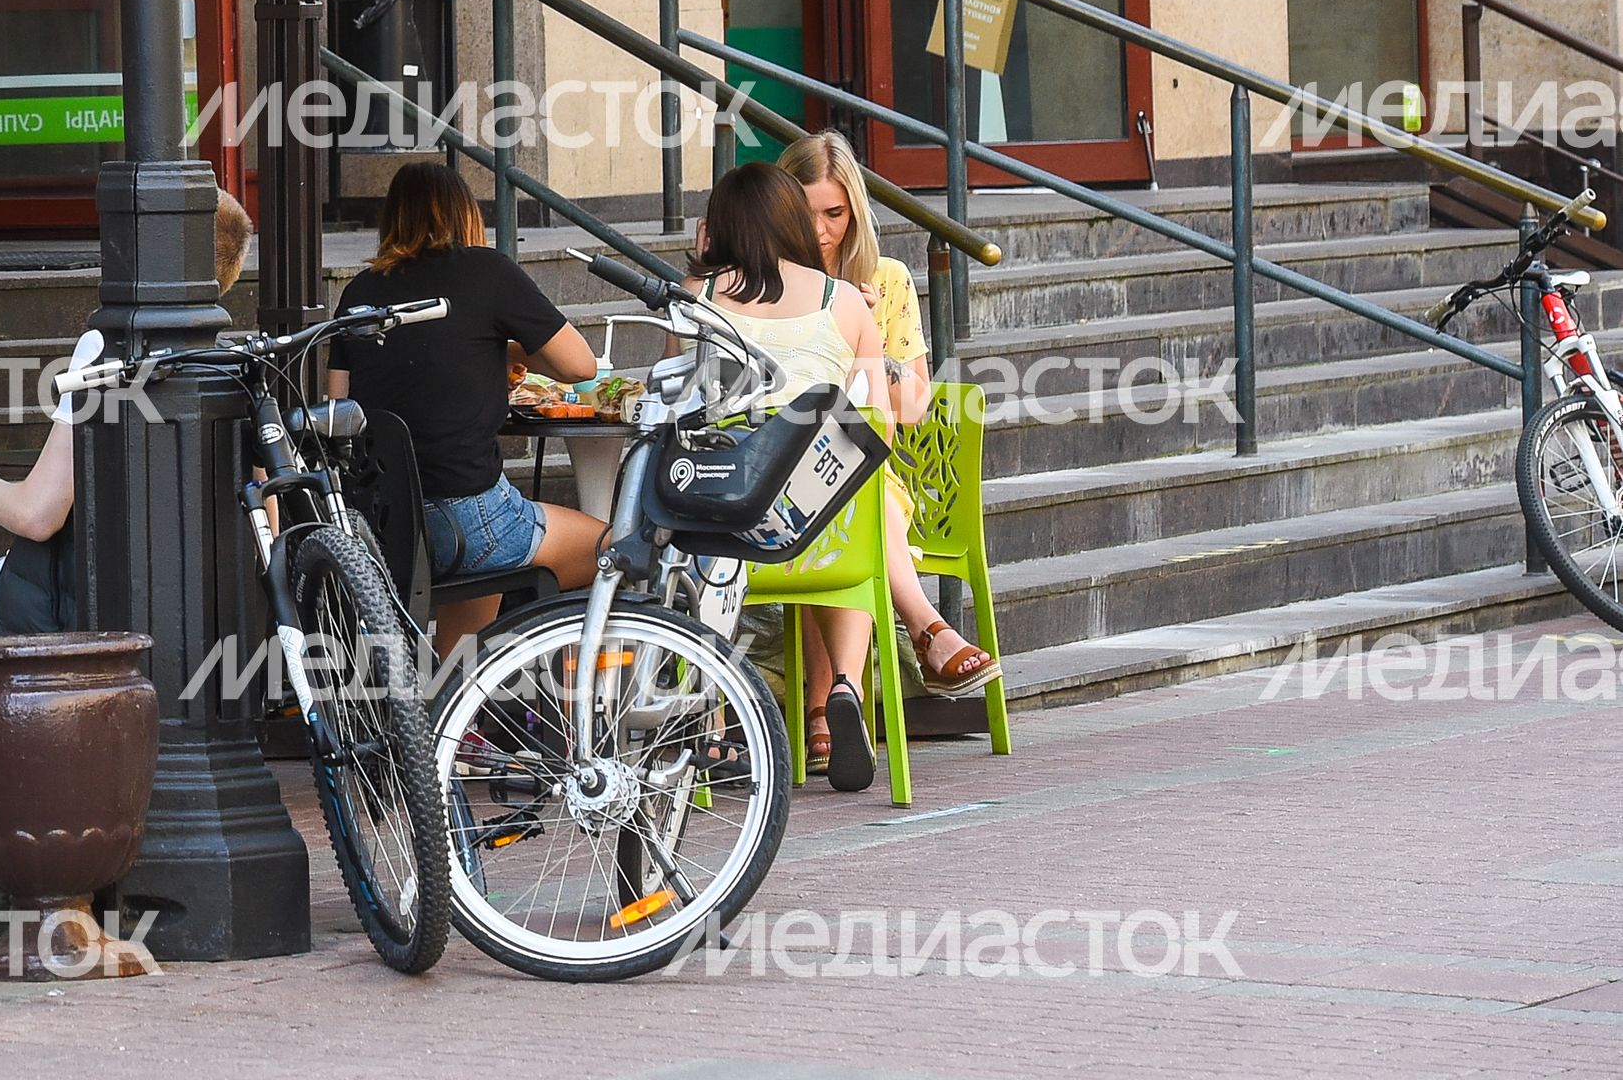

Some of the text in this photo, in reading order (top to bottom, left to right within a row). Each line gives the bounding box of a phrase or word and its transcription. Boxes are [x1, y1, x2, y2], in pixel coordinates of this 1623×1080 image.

[696, 463, 736, 472] Московский
[814, 449, 845, 487] ВТБ
[696, 471, 730, 480] Транспорт
